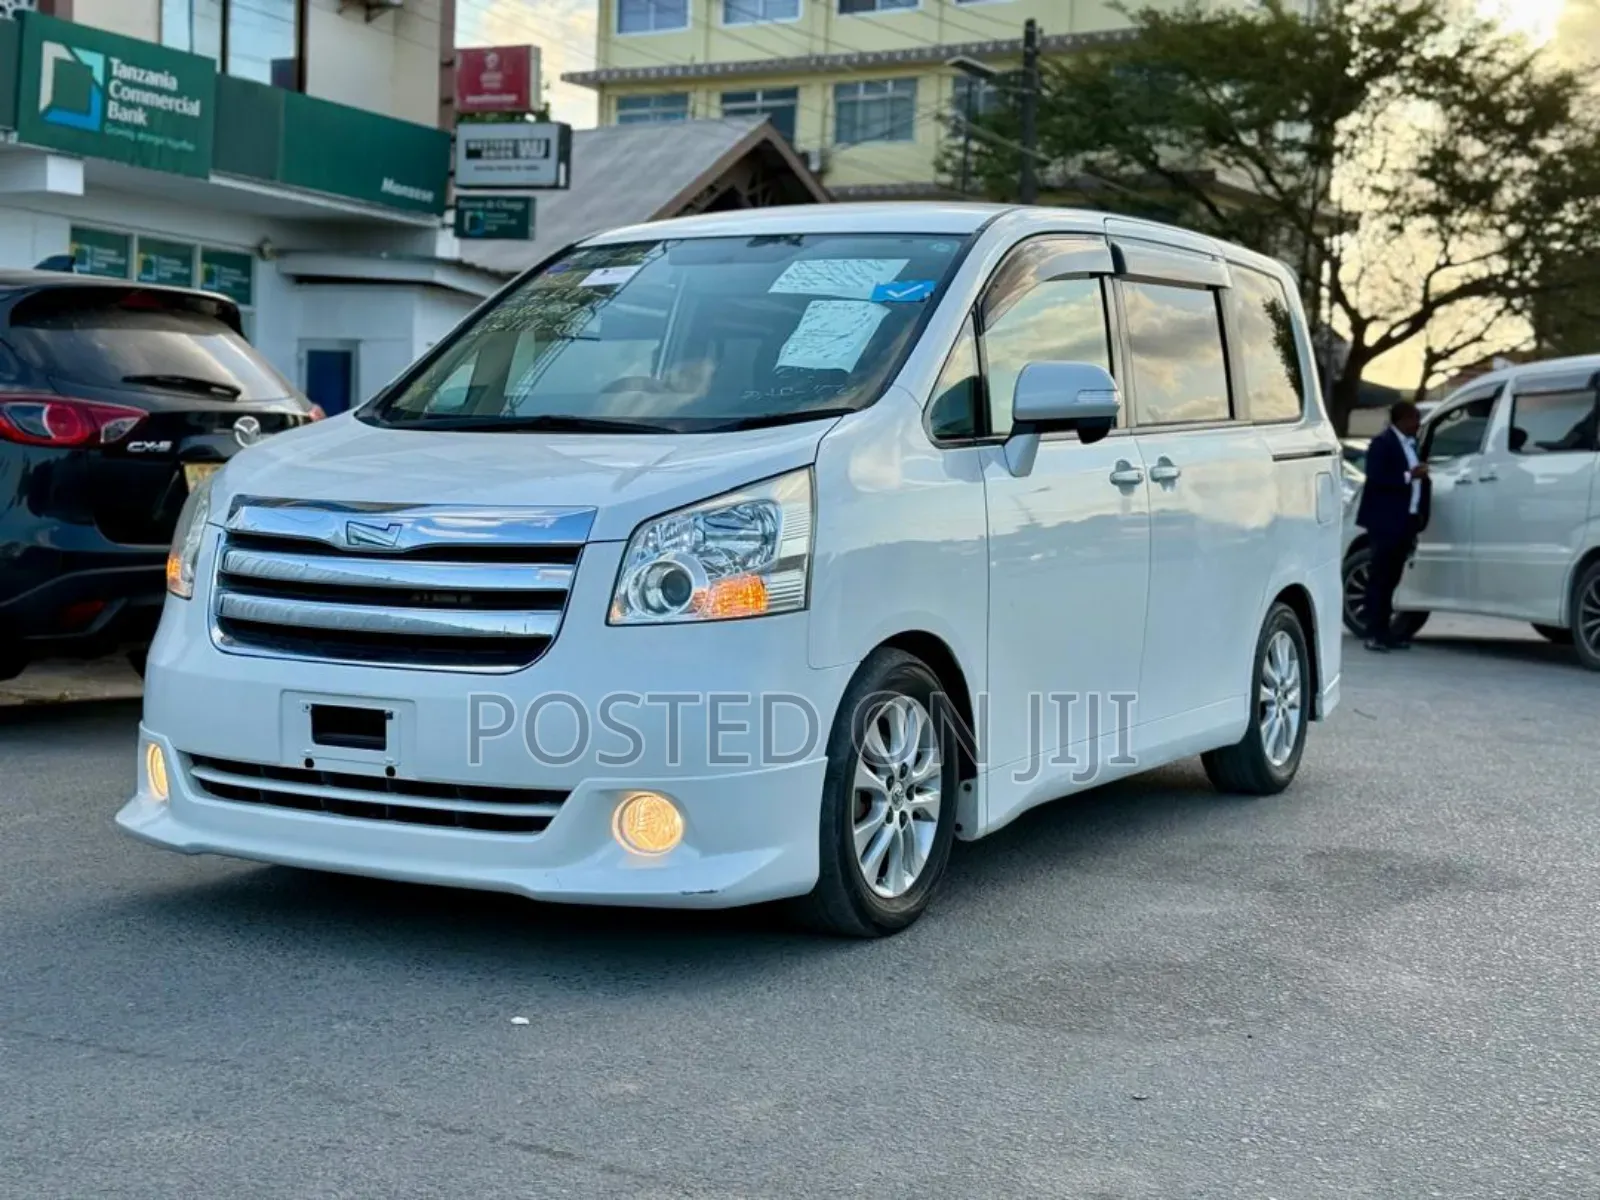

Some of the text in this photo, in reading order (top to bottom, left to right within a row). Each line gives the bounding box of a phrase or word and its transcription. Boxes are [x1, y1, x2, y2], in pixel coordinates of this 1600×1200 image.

[109, 56, 178, 92] Tanzania
[107, 99, 148, 127] Bank
[108, 79, 201, 117] Commercial
